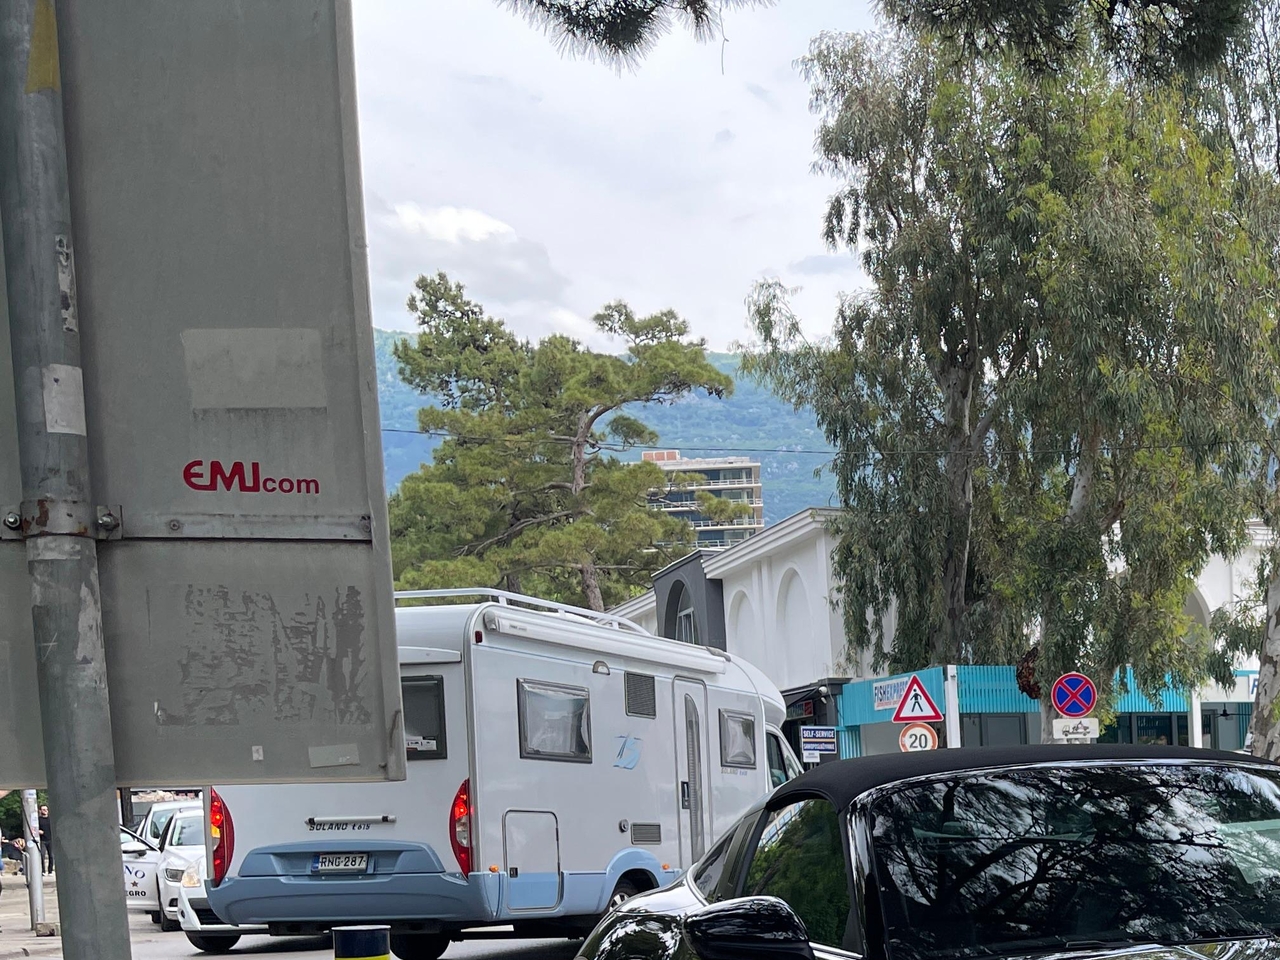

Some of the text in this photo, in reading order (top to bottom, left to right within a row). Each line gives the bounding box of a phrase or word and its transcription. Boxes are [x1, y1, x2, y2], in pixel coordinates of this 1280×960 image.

[803, 730, 835, 738] SELF-SERVICE
[909, 733, 928, 749] 20
[309, 823, 348, 831] SOLANO
